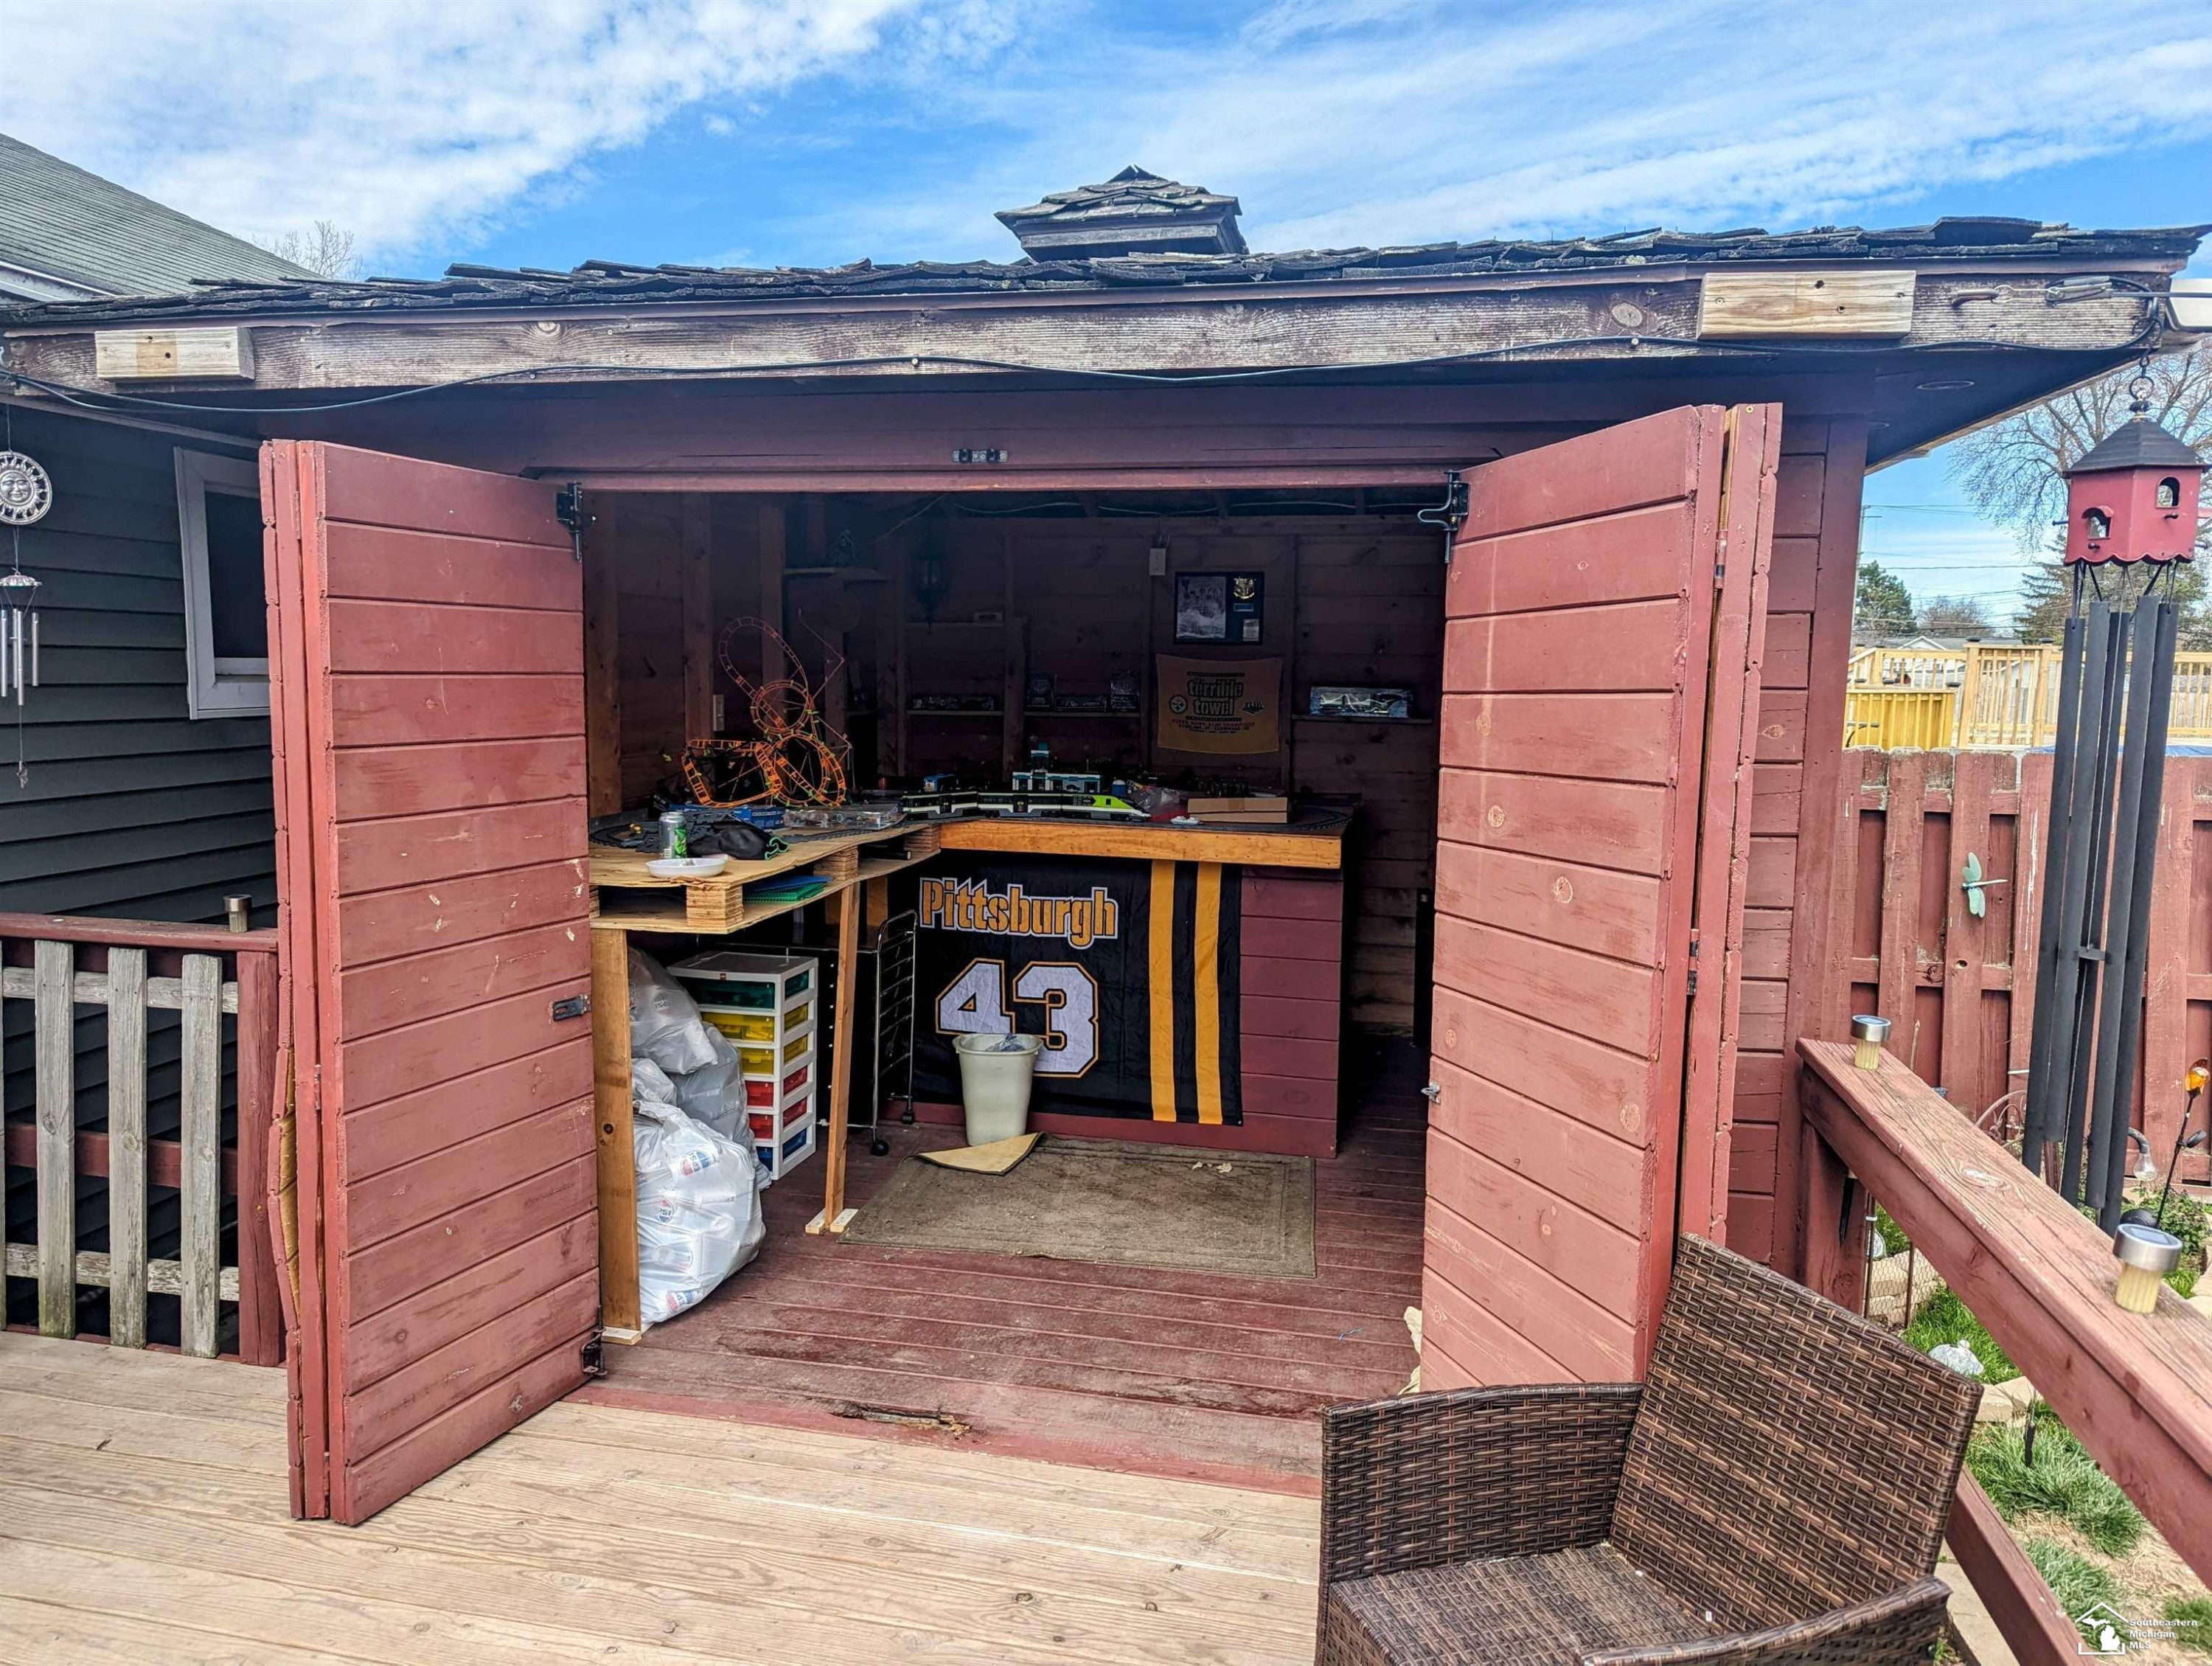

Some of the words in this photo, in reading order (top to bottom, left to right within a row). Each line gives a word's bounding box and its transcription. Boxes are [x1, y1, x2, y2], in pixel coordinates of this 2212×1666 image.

[1187, 678, 1243, 698] terrible
[1193, 698, 1235, 716] towel
[920, 877, 1119, 950] Pittsburgh
[936, 957, 1099, 1078] 43
